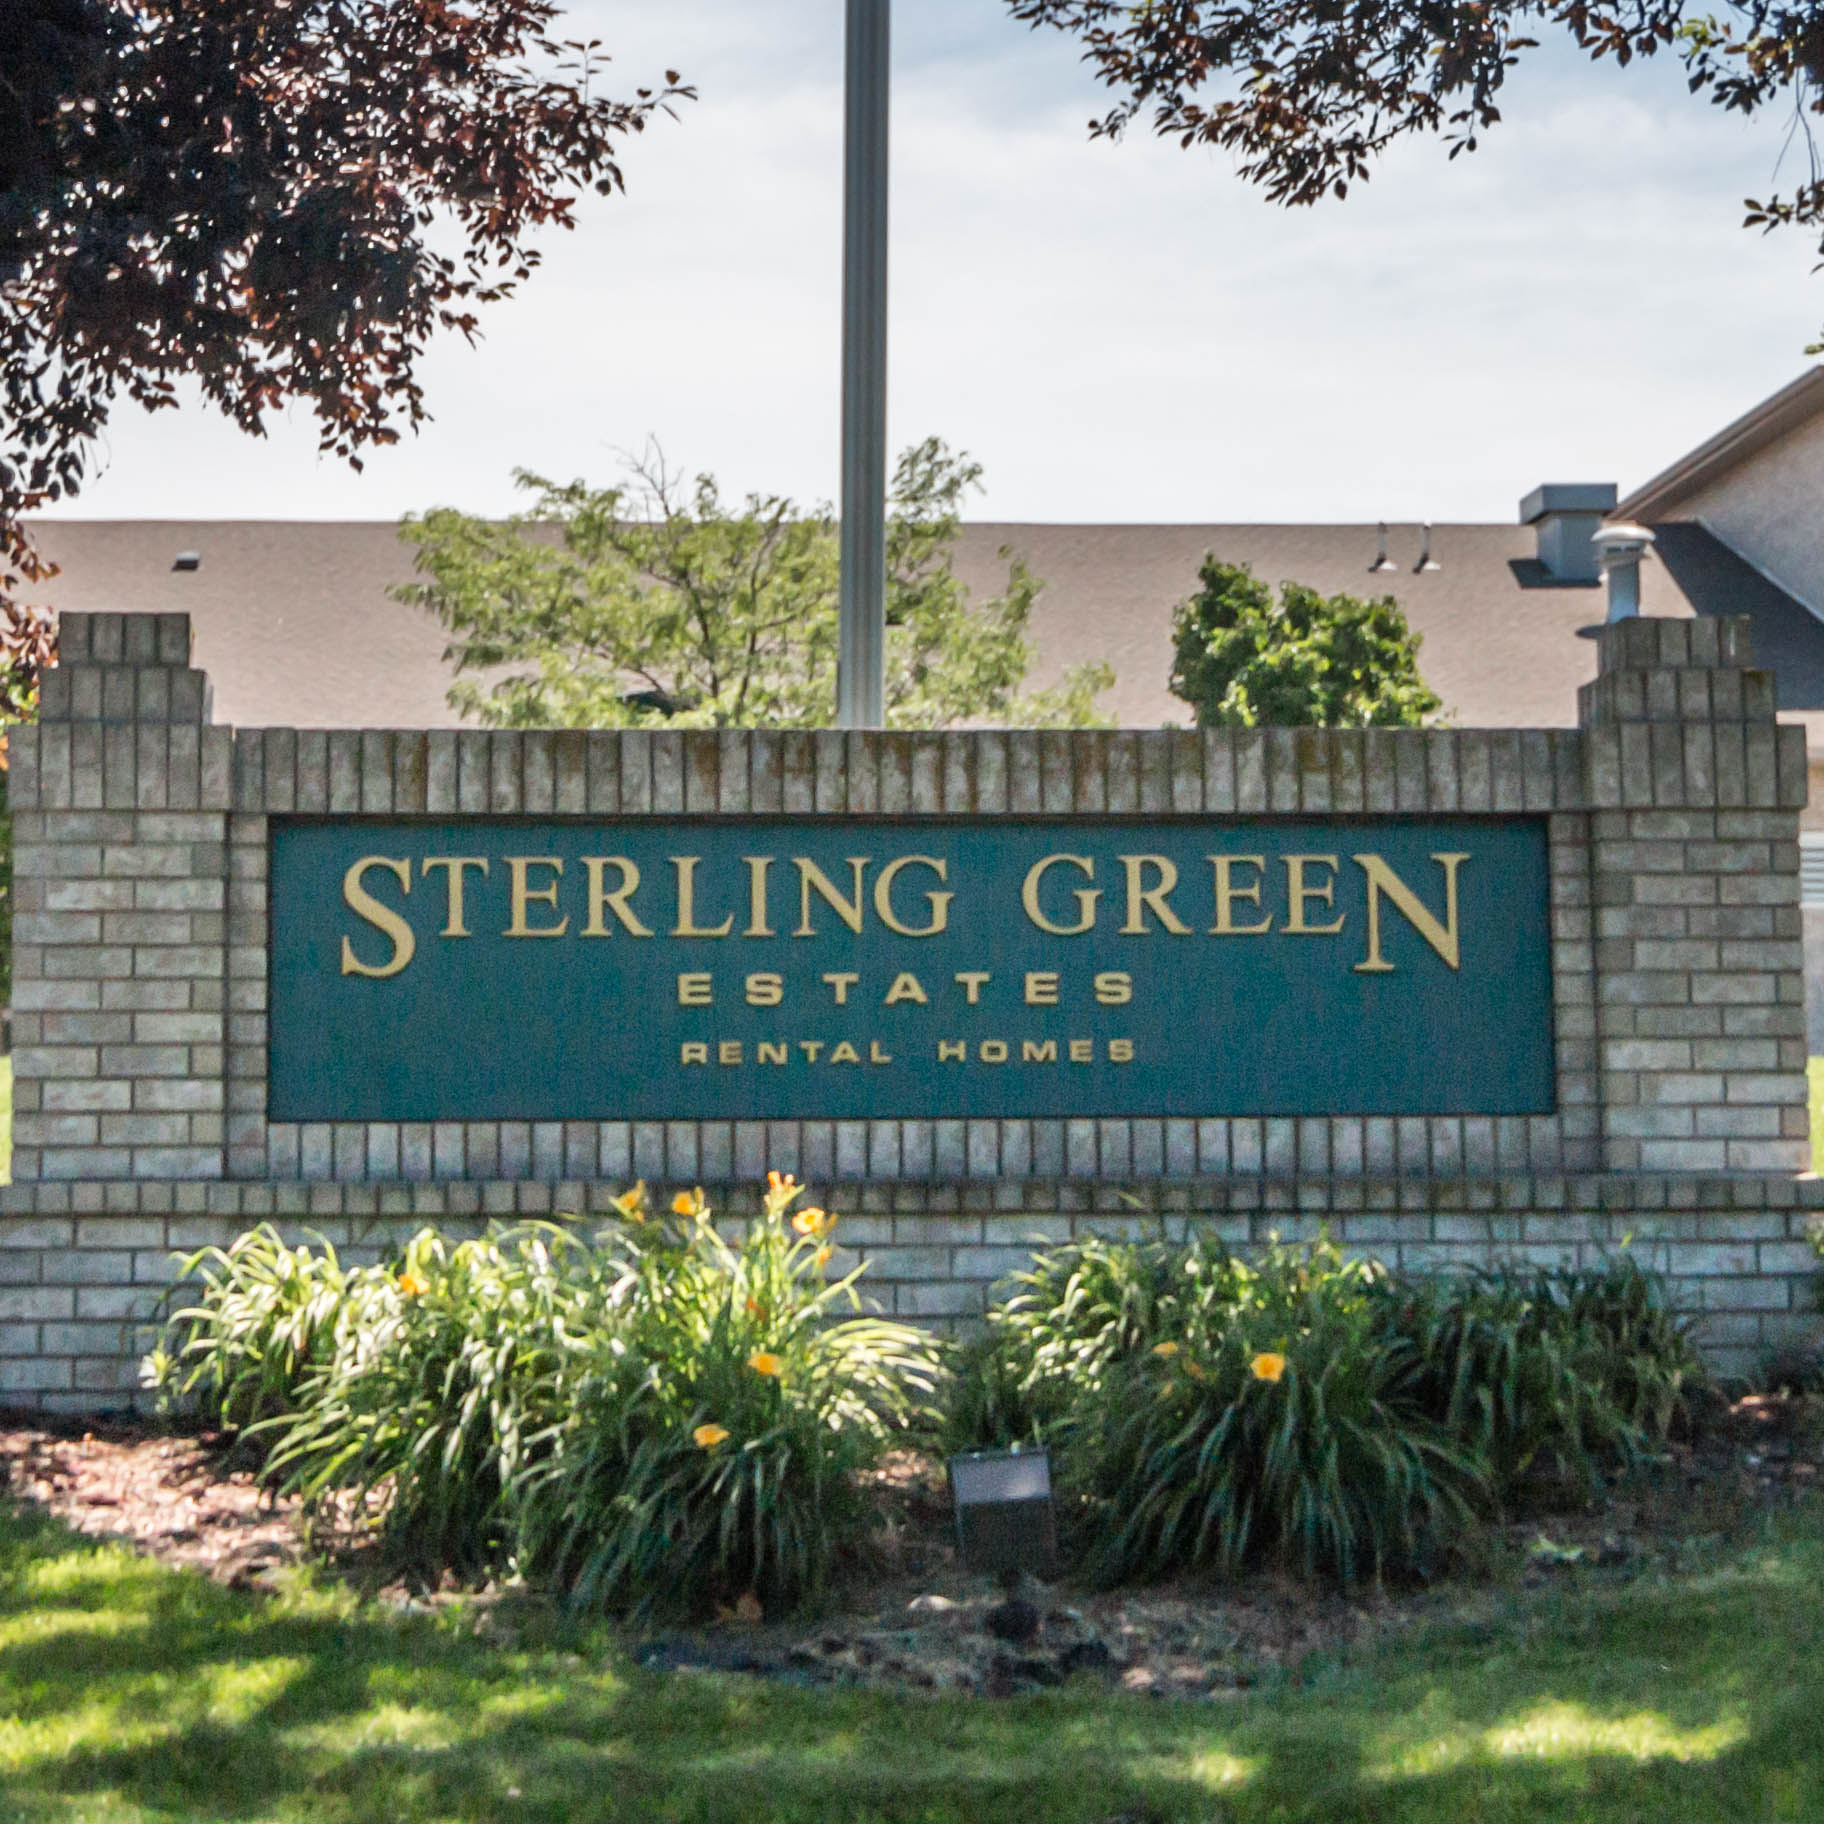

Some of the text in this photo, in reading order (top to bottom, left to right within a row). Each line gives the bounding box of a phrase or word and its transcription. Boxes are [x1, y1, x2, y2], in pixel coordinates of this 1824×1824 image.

[340, 852, 1471, 979] STERLING GREEN
[678, 972, 1133, 1007] ESTATES
[680, 1038, 1134, 1066] RENTAL HOMES
